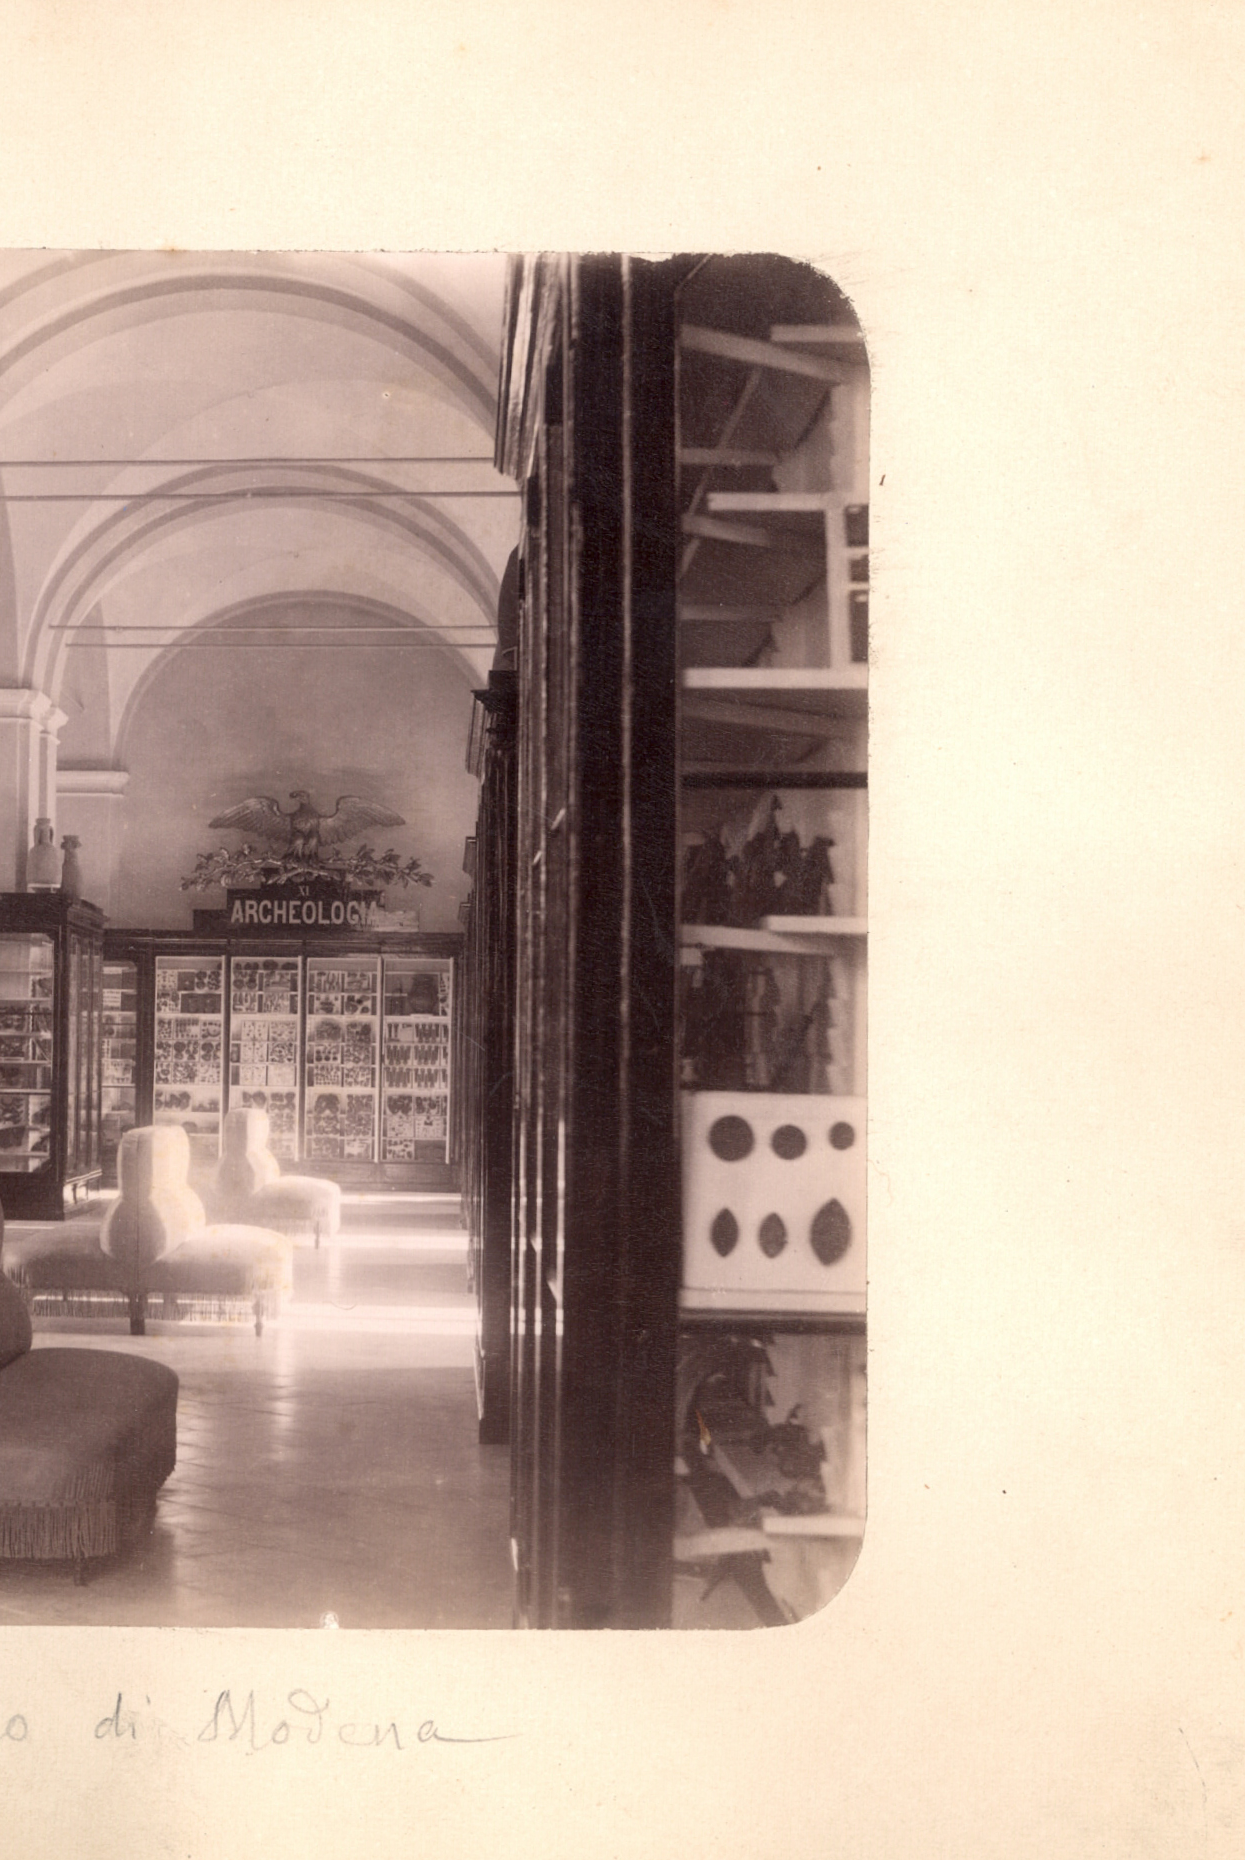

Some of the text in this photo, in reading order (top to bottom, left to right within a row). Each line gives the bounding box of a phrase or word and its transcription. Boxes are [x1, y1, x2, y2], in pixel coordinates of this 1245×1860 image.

[230, 900, 378, 925] ARCHEOLOGIA
[94, 1691, 151, 1741] di
[197, 1688, 523, 1752] Modena
